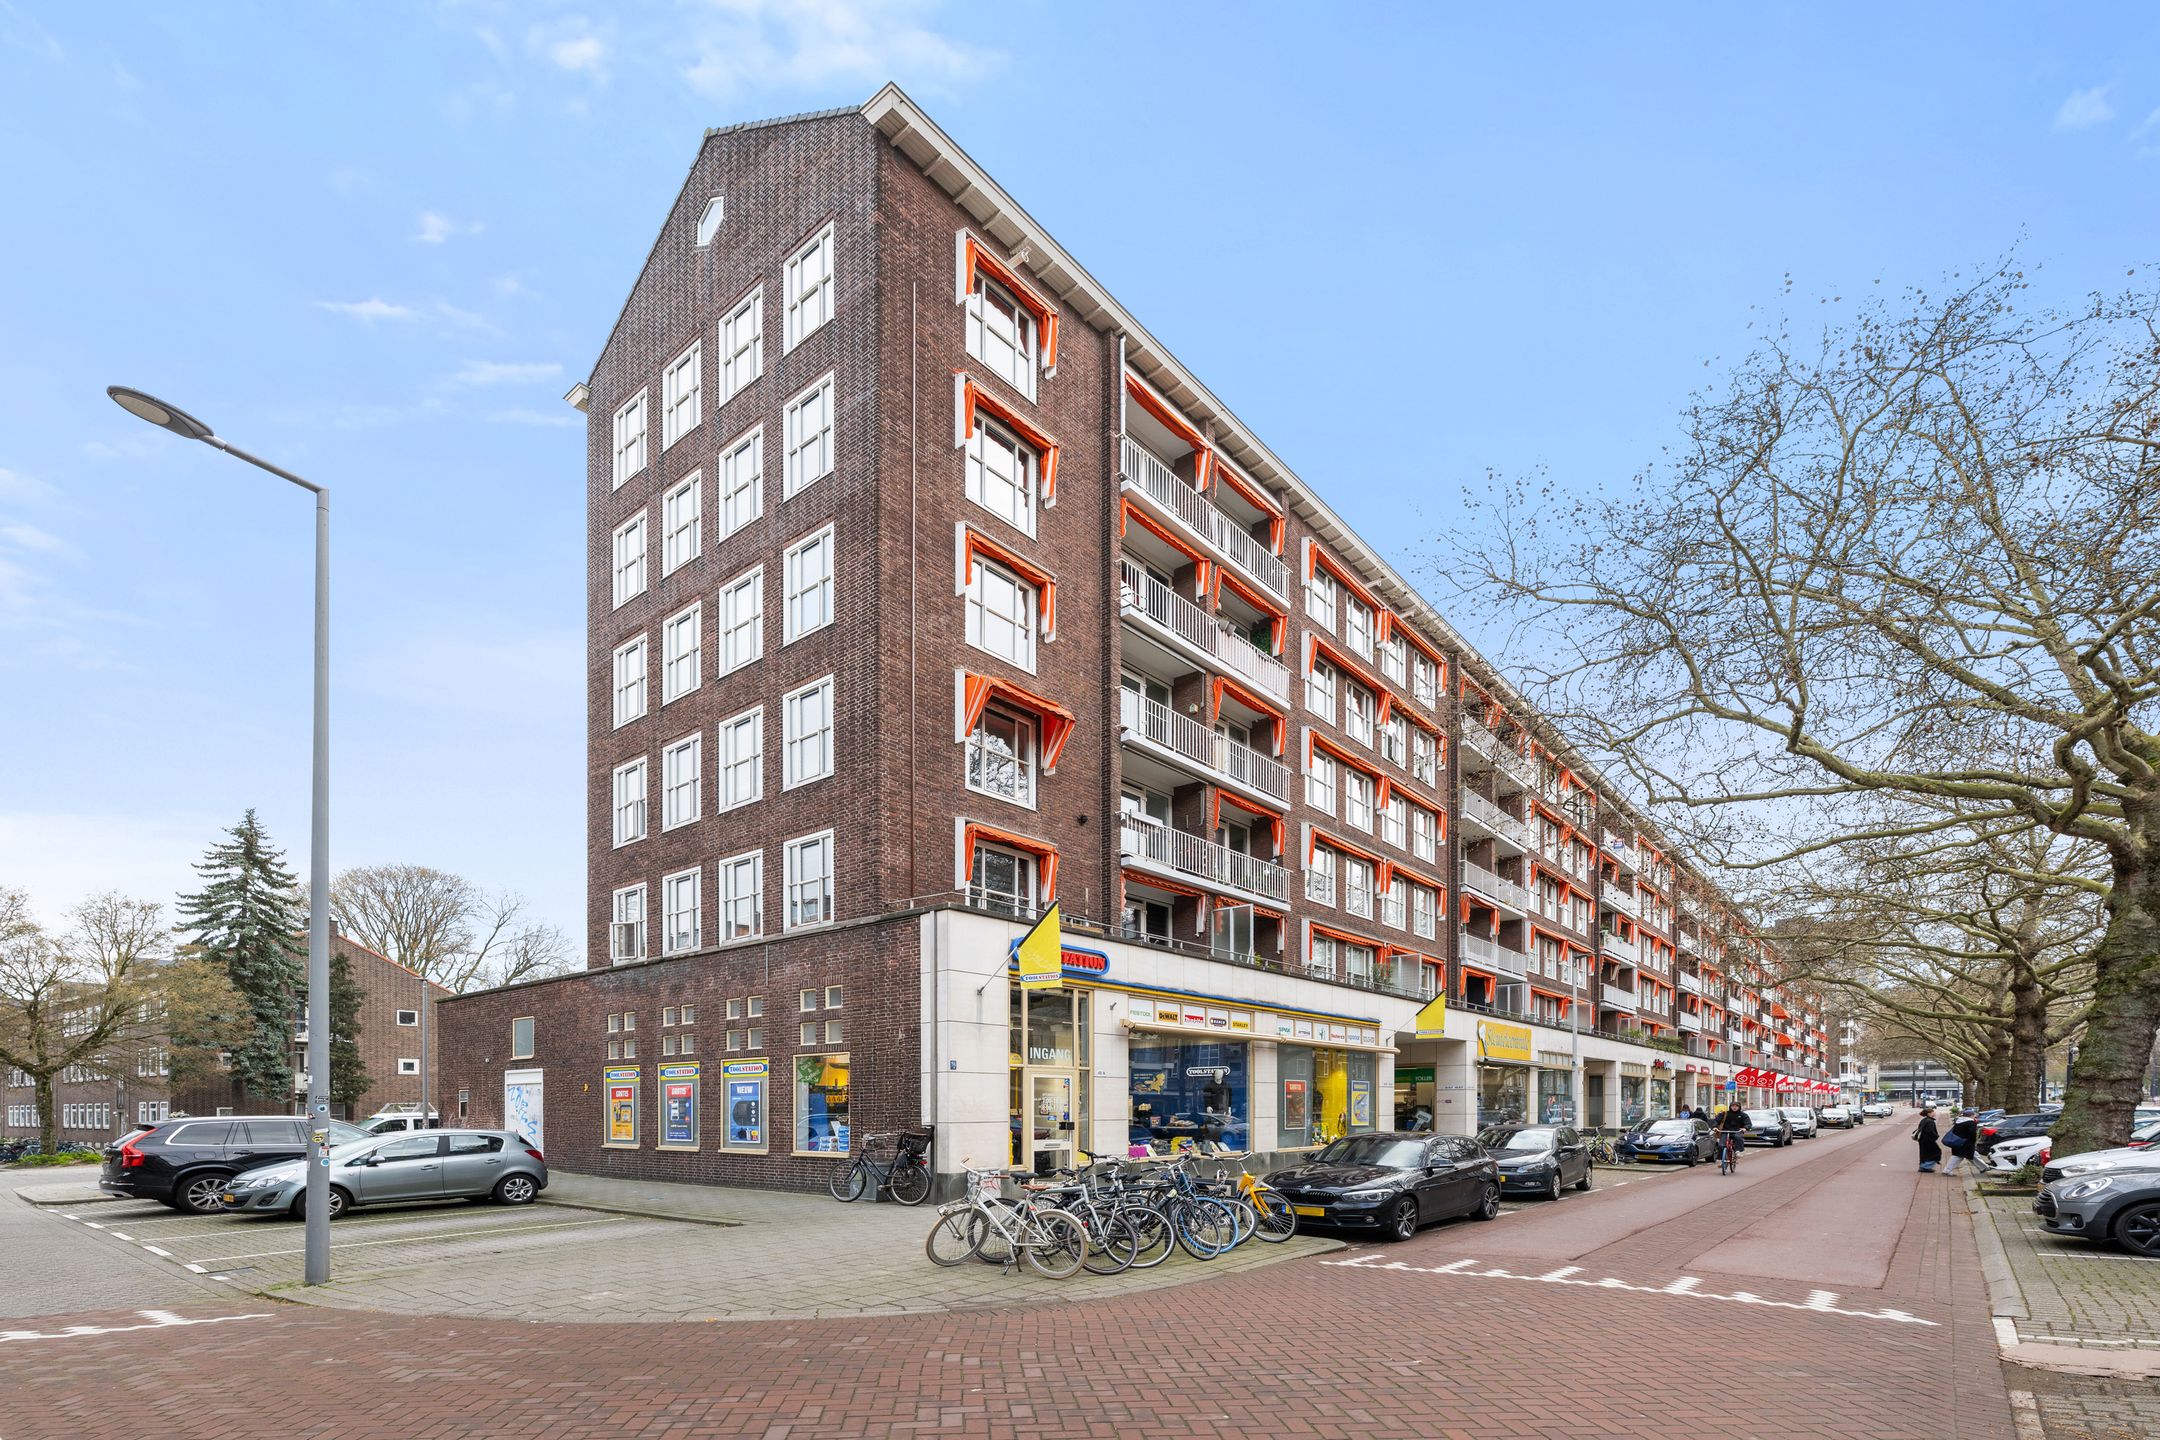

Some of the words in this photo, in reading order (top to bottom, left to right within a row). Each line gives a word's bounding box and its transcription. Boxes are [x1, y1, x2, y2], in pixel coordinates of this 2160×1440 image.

[1029, 1047, 1072, 1060] INGANG
[665, 1068, 694, 1076] TOOLSTATION
[729, 1064, 762, 1073] TOOLSTATION
[610, 1071, 636, 1079] TOOLSTATION
[736, 1085, 753, 1094] NIEUW
